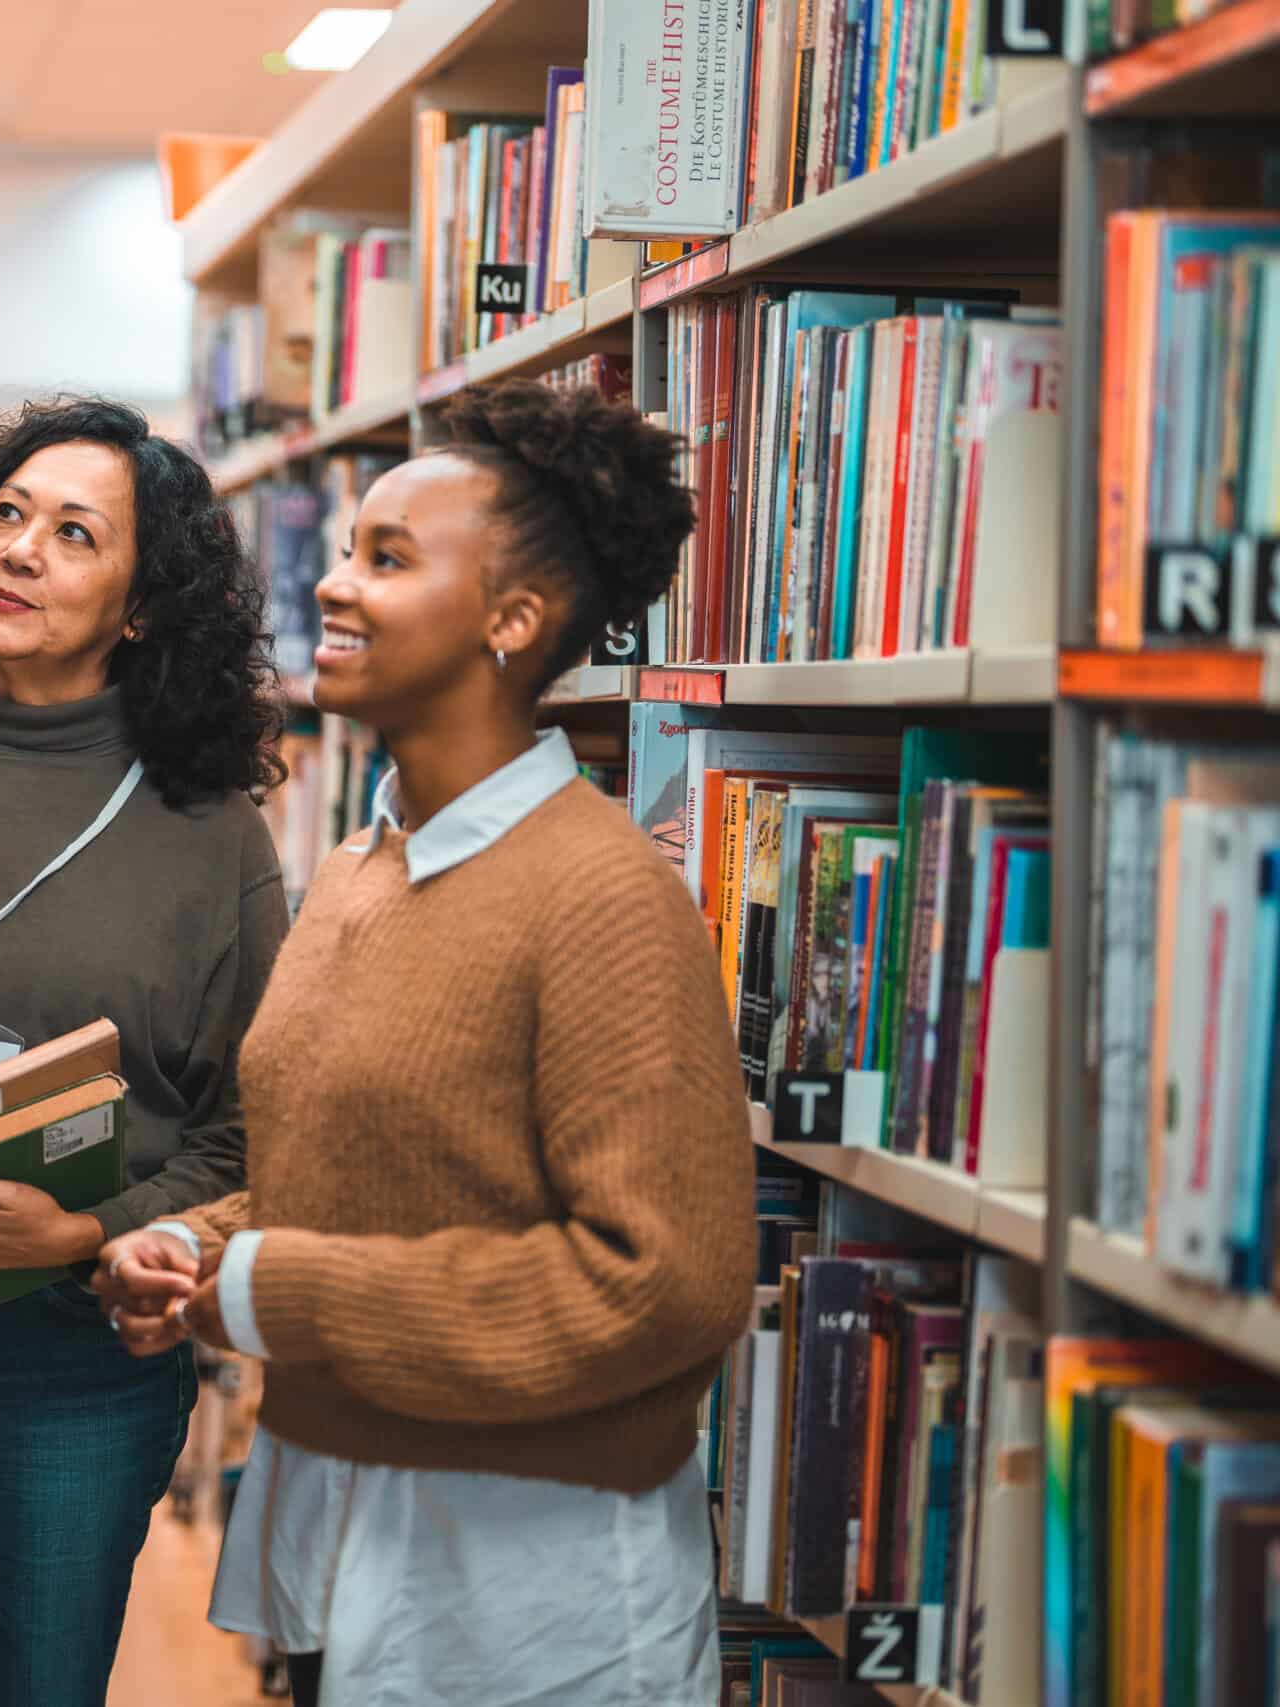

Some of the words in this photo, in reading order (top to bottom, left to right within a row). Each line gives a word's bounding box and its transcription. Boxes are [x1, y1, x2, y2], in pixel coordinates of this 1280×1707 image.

[1002, 0, 1051, 50] L
[646, 59, 657, 84] THE
[691, 0, 712, 147] KOSTÜMGESCHIC
[656, 69, 681, 206] COSTUME
[708, 78, 726, 159] COSTUME
[689, 151, 705, 182] DIE
[706, 158, 721, 182] LE
[481, 274, 522, 304] Ku
[1158, 552, 1220, 631] R
[787, 1080, 831, 1134] T
[857, 1612, 904, 1679] Ž
